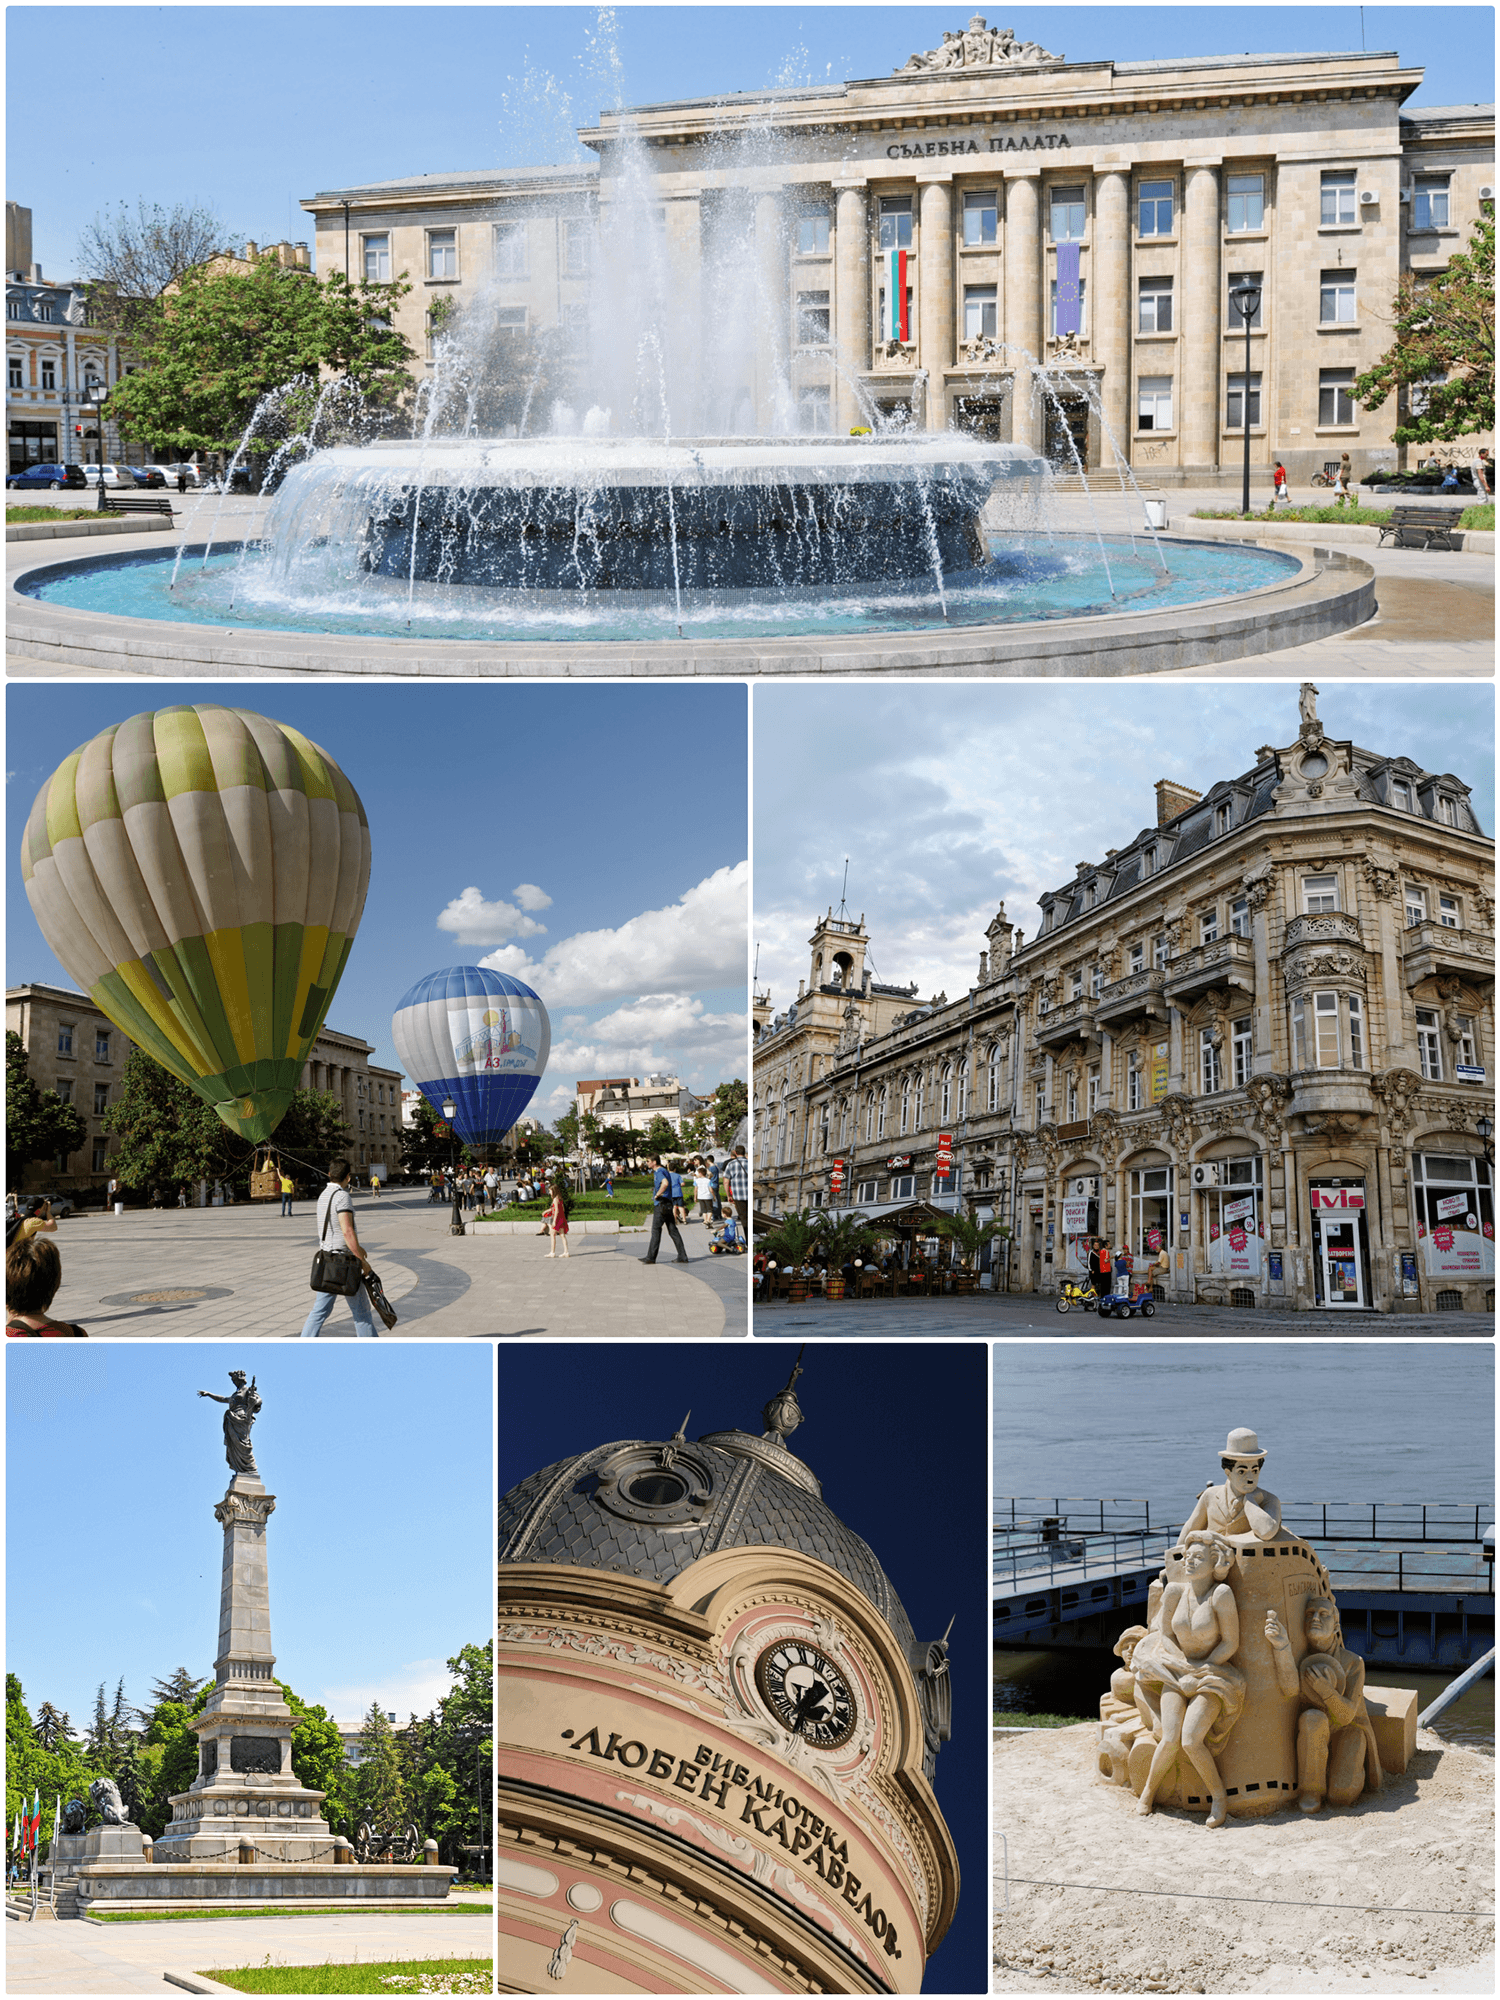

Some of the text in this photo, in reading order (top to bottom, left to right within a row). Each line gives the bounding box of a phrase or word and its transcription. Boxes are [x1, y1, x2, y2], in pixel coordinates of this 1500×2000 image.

[886, 133, 1072, 160] СЪДЕБНА ПАЛАТА
[1311, 1189, 1365, 1208] Ivis
[570, 1726, 899, 1955] ЛЮБЕН КАРАВЕЛОВ
[694, 1743, 851, 1864] БИБЛИОТЕКА
